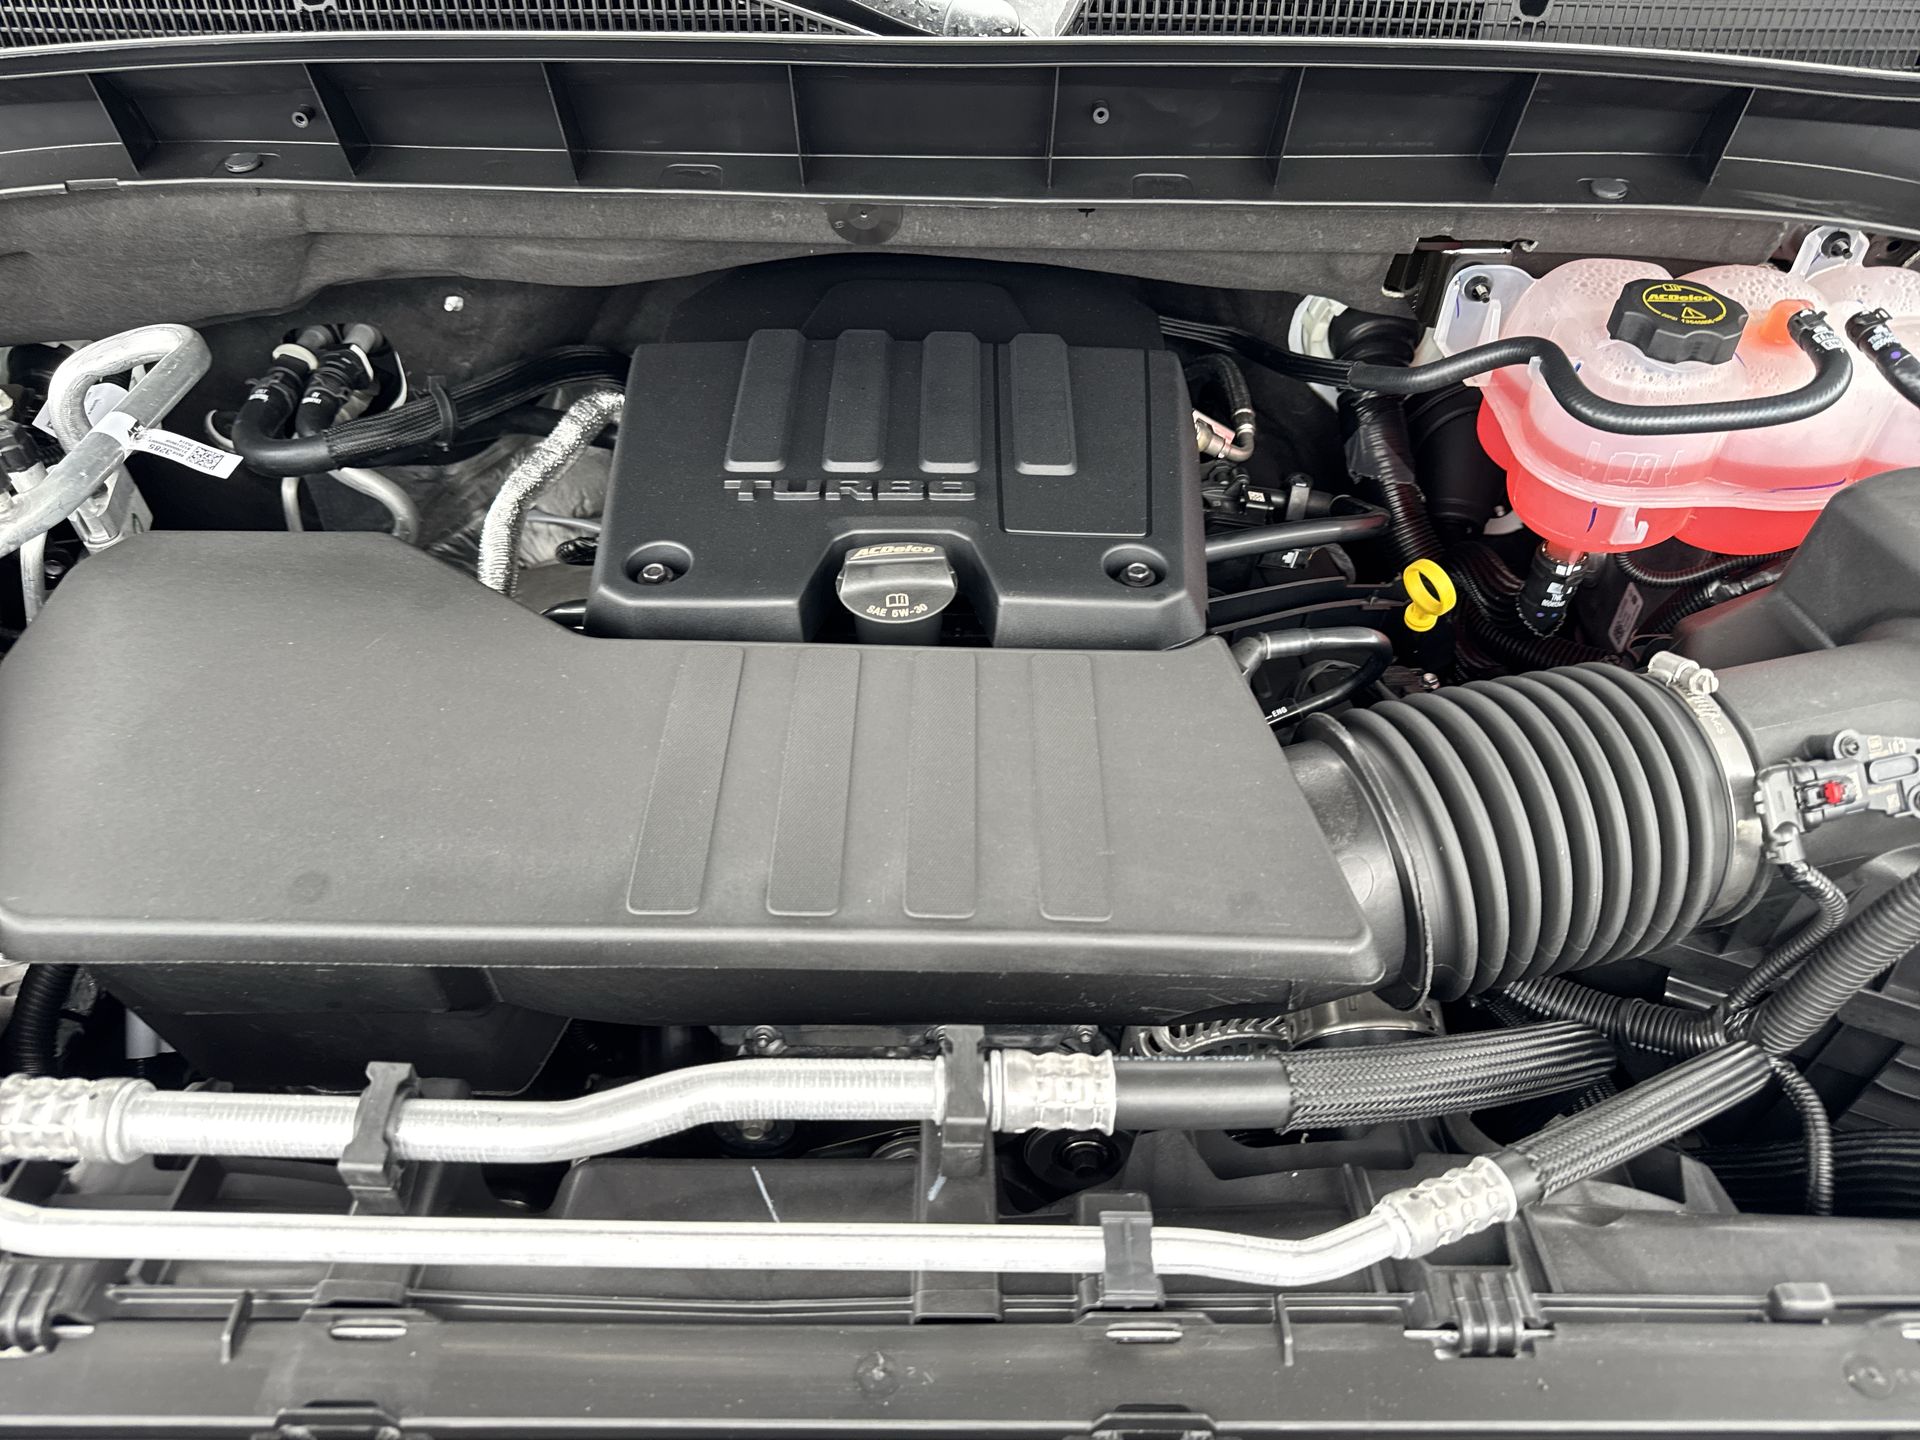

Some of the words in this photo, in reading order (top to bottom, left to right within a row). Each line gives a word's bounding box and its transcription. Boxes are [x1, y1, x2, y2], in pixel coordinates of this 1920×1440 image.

[1647, 293, 1713, 302] ACDelco
[723, 479, 977, 501] TURBO
[850, 544, 936, 560] ACDelco
[866, 604, 888, 617] SAE
[891, 603, 929, 618] 5W-30
